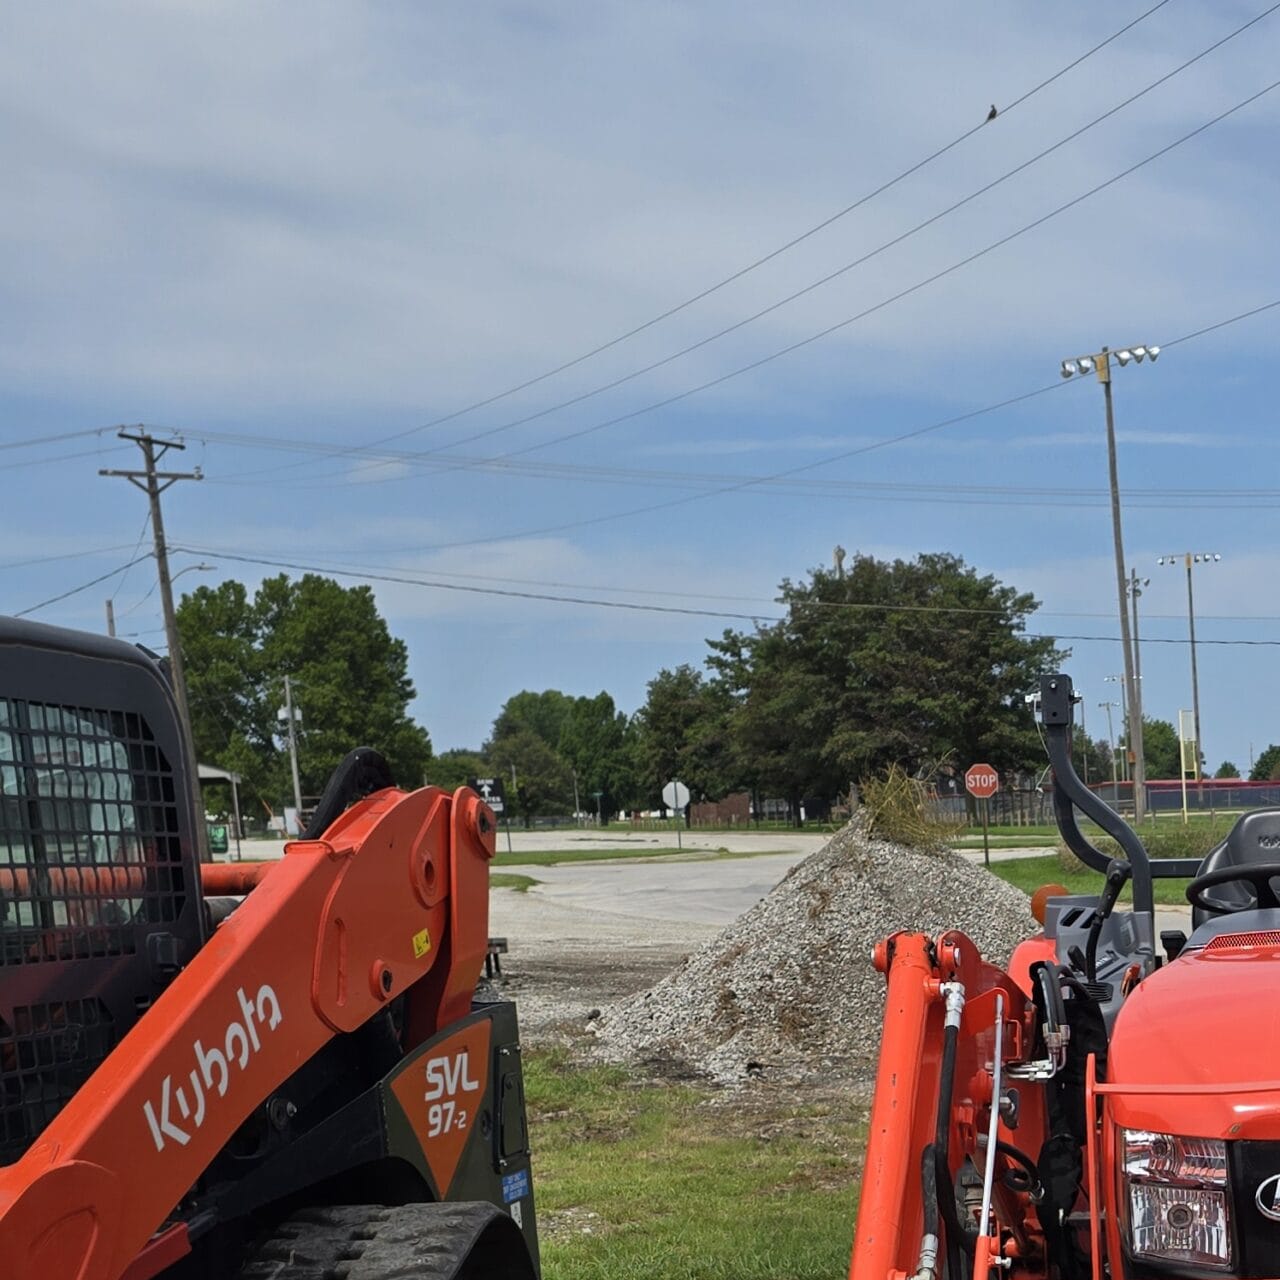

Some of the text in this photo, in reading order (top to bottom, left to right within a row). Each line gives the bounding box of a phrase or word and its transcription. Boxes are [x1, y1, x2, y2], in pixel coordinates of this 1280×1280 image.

[968, 774, 996, 788] STOP
[143, 984, 283, 1153] Kubota
[424, 1052, 479, 1102] SVL
